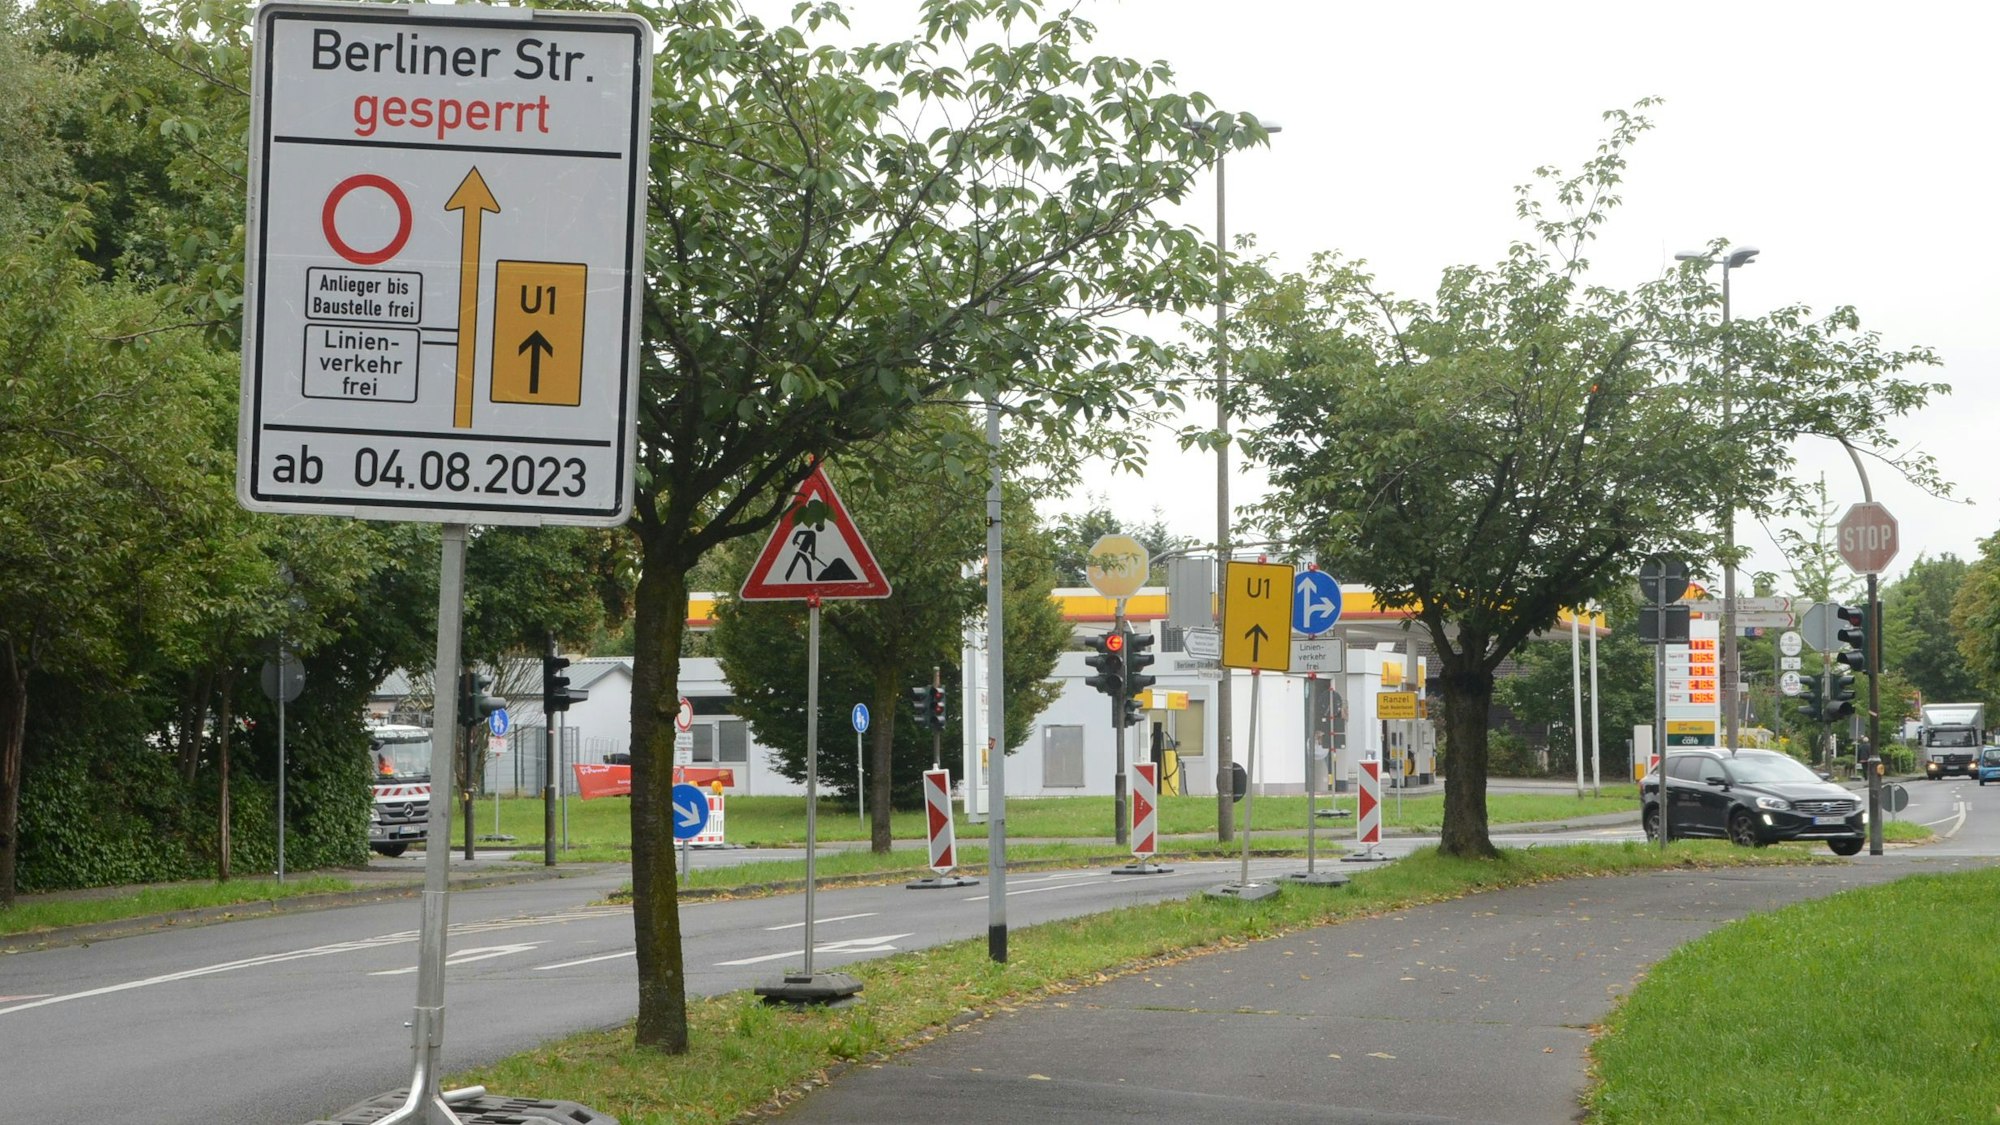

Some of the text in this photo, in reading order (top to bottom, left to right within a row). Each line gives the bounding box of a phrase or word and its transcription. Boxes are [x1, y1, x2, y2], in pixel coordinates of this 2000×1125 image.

[313, 28, 594, 82] Berliner Str.
[354, 94, 550, 140] gesperrt
[320, 274, 409, 297] Anlieger bis
[313, 297, 414, 318] Baustelle frei
[520, 285, 556, 315] U1
[325, 329, 400, 351] Linien-
[320, 354, 403, 374] verkehr
[342, 376, 378, 396] frei
[272, 444, 587, 497] ab 04.08.2023
[1844, 524, 1892, 552] STOP
[1247, 577, 1270, 600] U1
[1298, 653, 1326, 661] verkehr
[1300, 643, 1325, 652] Linien-
[1306, 662, 1320, 671] frei
[1383, 695, 1410, 703] Ranzel
